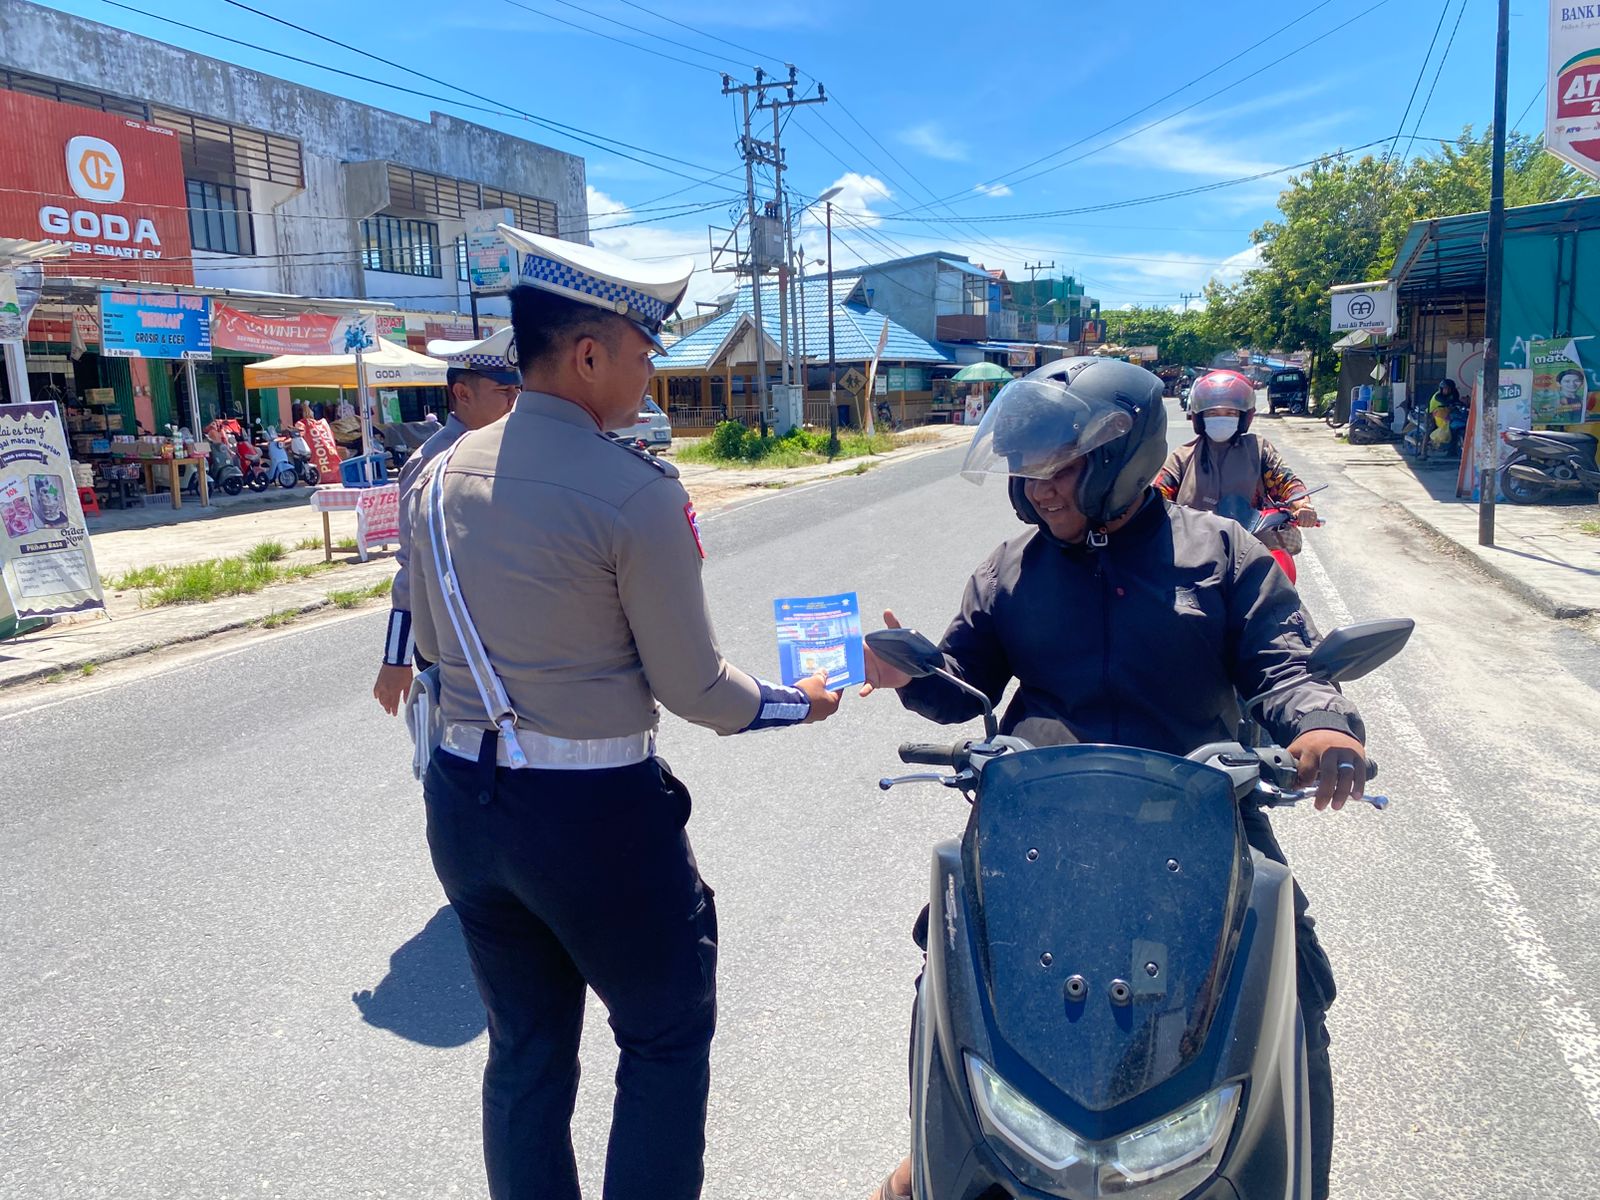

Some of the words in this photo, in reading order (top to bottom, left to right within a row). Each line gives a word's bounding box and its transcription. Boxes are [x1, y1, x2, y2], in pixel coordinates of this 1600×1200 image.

[1562, 5, 1594, 21] BANK
[39, 205, 161, 246] GODA
[94, 244, 140, 258] SMART
[143, 250, 161, 259] EV
[264, 324, 311, 338] WINFLY
[135, 333, 158, 344] GROSIR
[168, 335, 185, 344] ECER
[375, 370, 401, 379] GODA
[1504, 386, 1520, 398] Teh
[39, 441, 61, 457] varian
[310, 428, 332, 473] PROMO
[363, 496, 375, 509] ES
[60, 527, 85, 537] Order
[66, 535, 84, 546] Now
